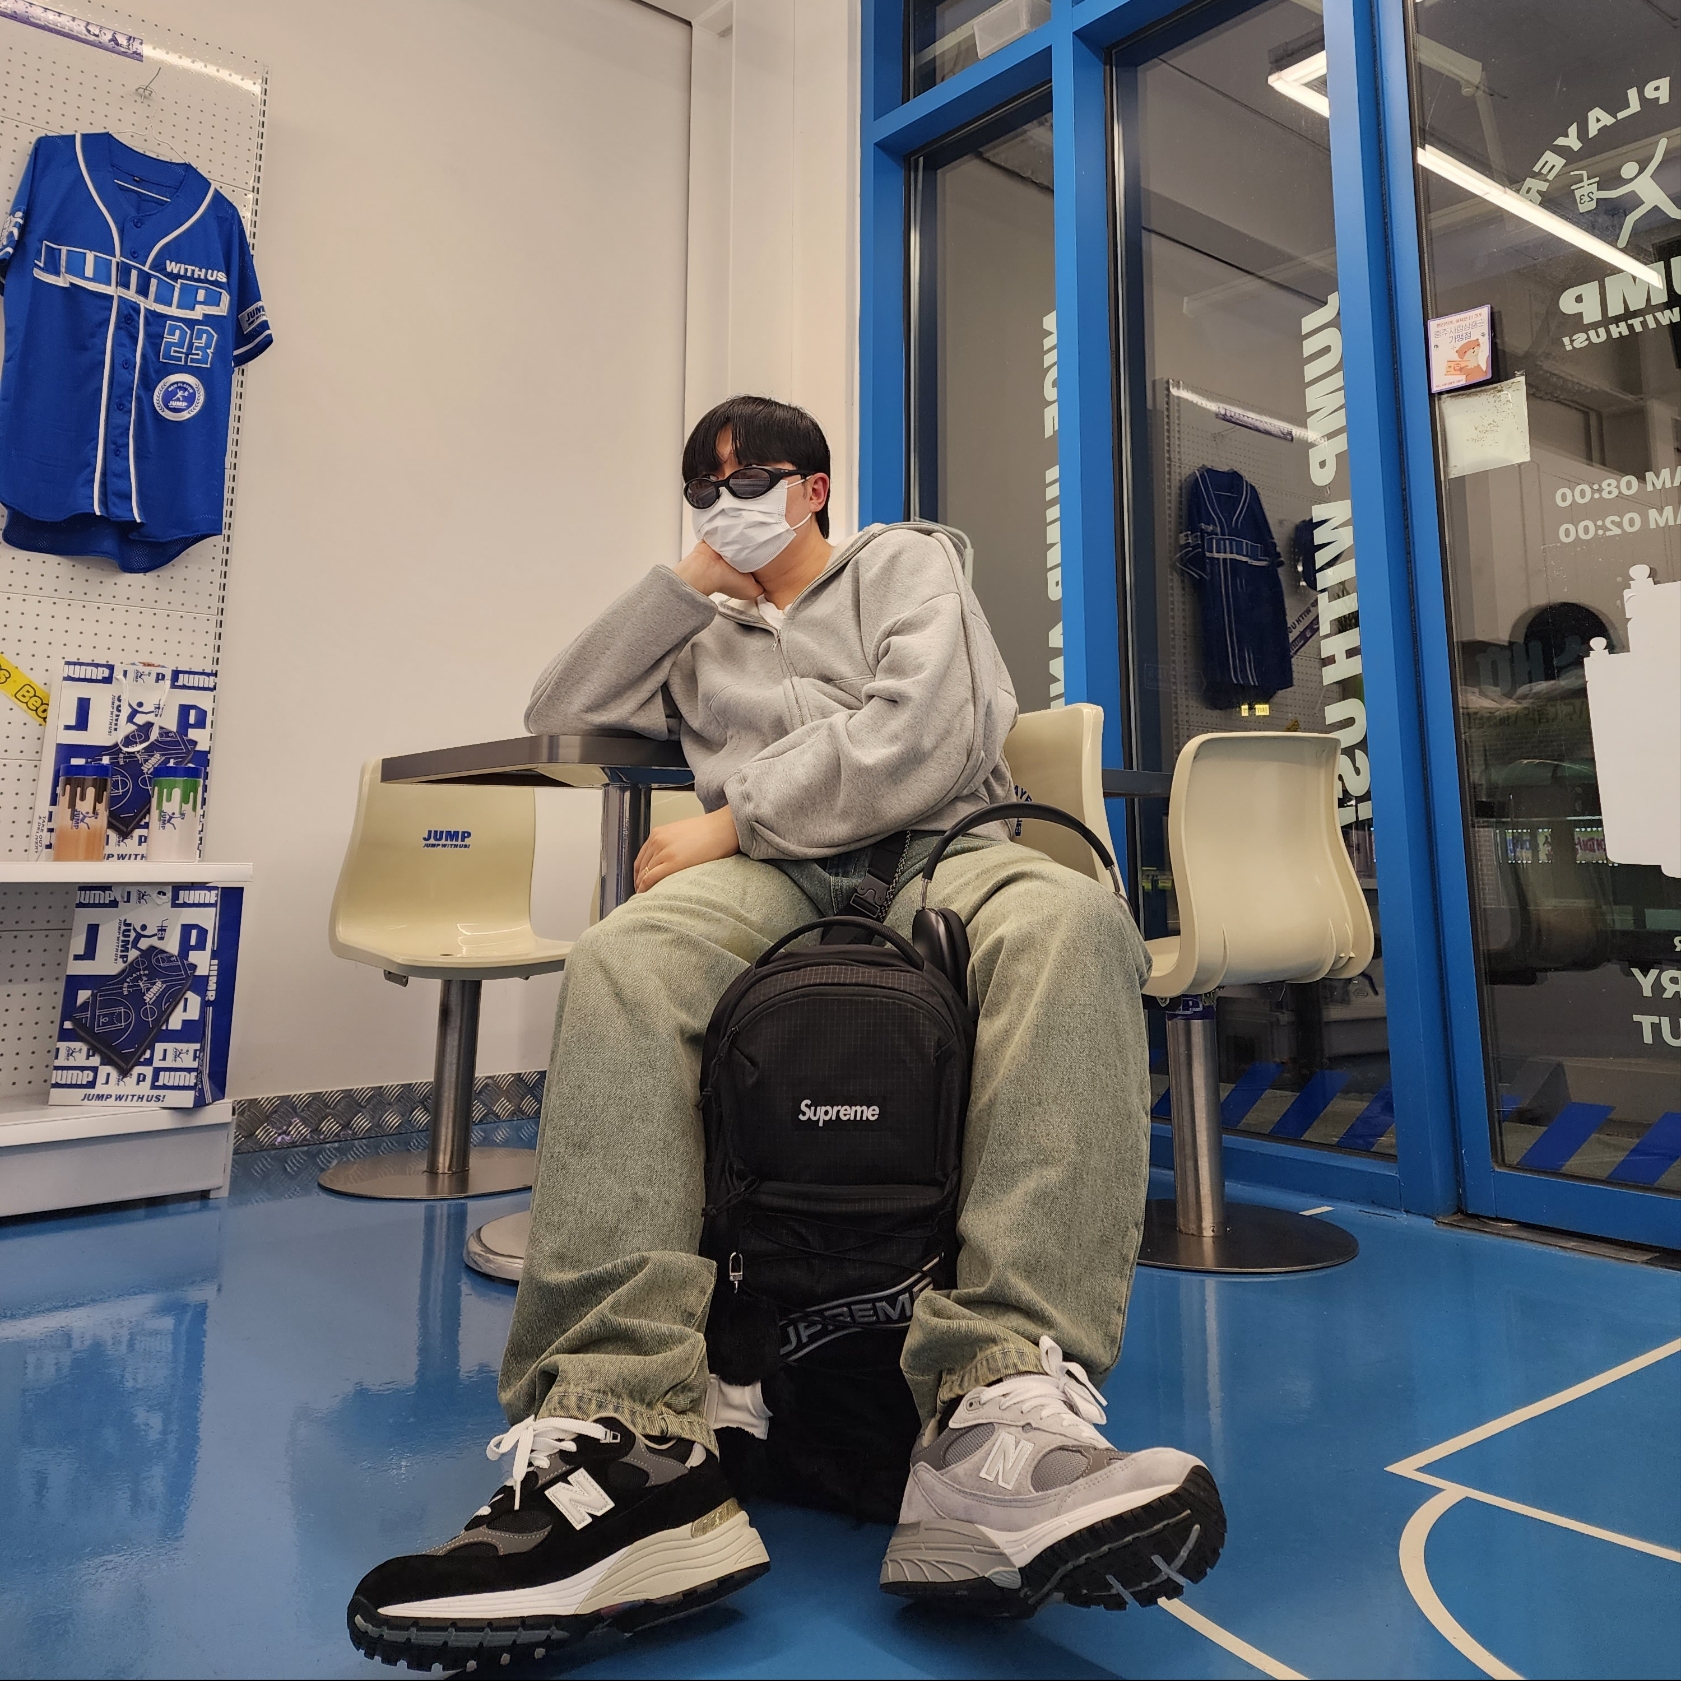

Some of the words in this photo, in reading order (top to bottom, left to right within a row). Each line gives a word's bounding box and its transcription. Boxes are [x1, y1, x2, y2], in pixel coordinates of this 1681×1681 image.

[33, 241, 230, 320] JUMP
[160, 320, 218, 368] 23
[422, 830, 472, 842] JUMP
[119, 918, 132, 964] JUMP
[143, 980, 163, 1003] JUMP
[81, 1093, 113, 1102] JUMP
[798, 1099, 880, 1127] Supreme
[980, 1431, 1035, 1491] N
[544, 1467, 616, 1531] N
